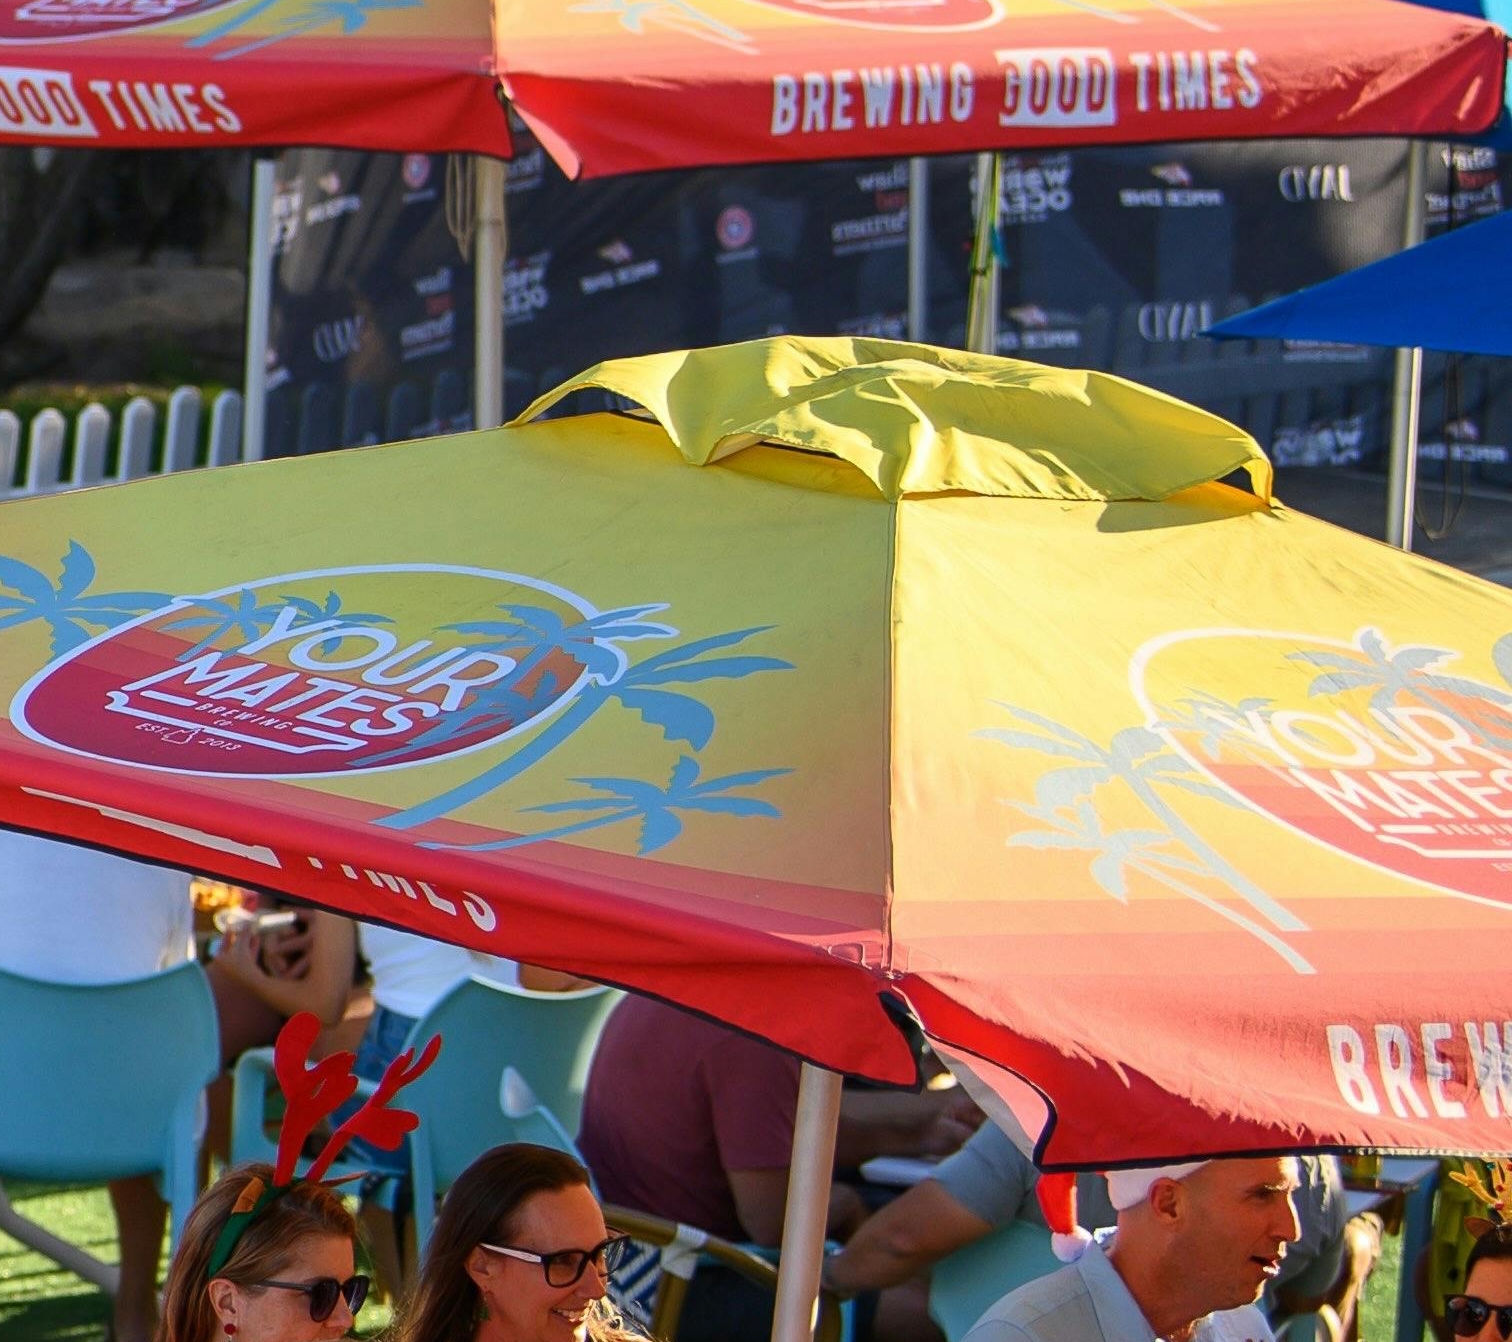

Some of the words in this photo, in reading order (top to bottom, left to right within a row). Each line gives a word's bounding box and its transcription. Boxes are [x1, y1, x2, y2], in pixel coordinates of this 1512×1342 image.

[89, 80, 243, 133] TIMES
[770, 63, 976, 136] BREWING
[1003, 53, 1108, 117] GOOD
[1129, 49, 1263, 111] TIMES
[121, 651, 442, 737] MATES
[237, 606, 517, 712] YOUR
[195, 701, 296, 732] BREWING
[198, 736, 242, 751] 2013
[1199, 707, 1512, 771] YOUR
[1326, 1022, 1512, 1119] BREW
